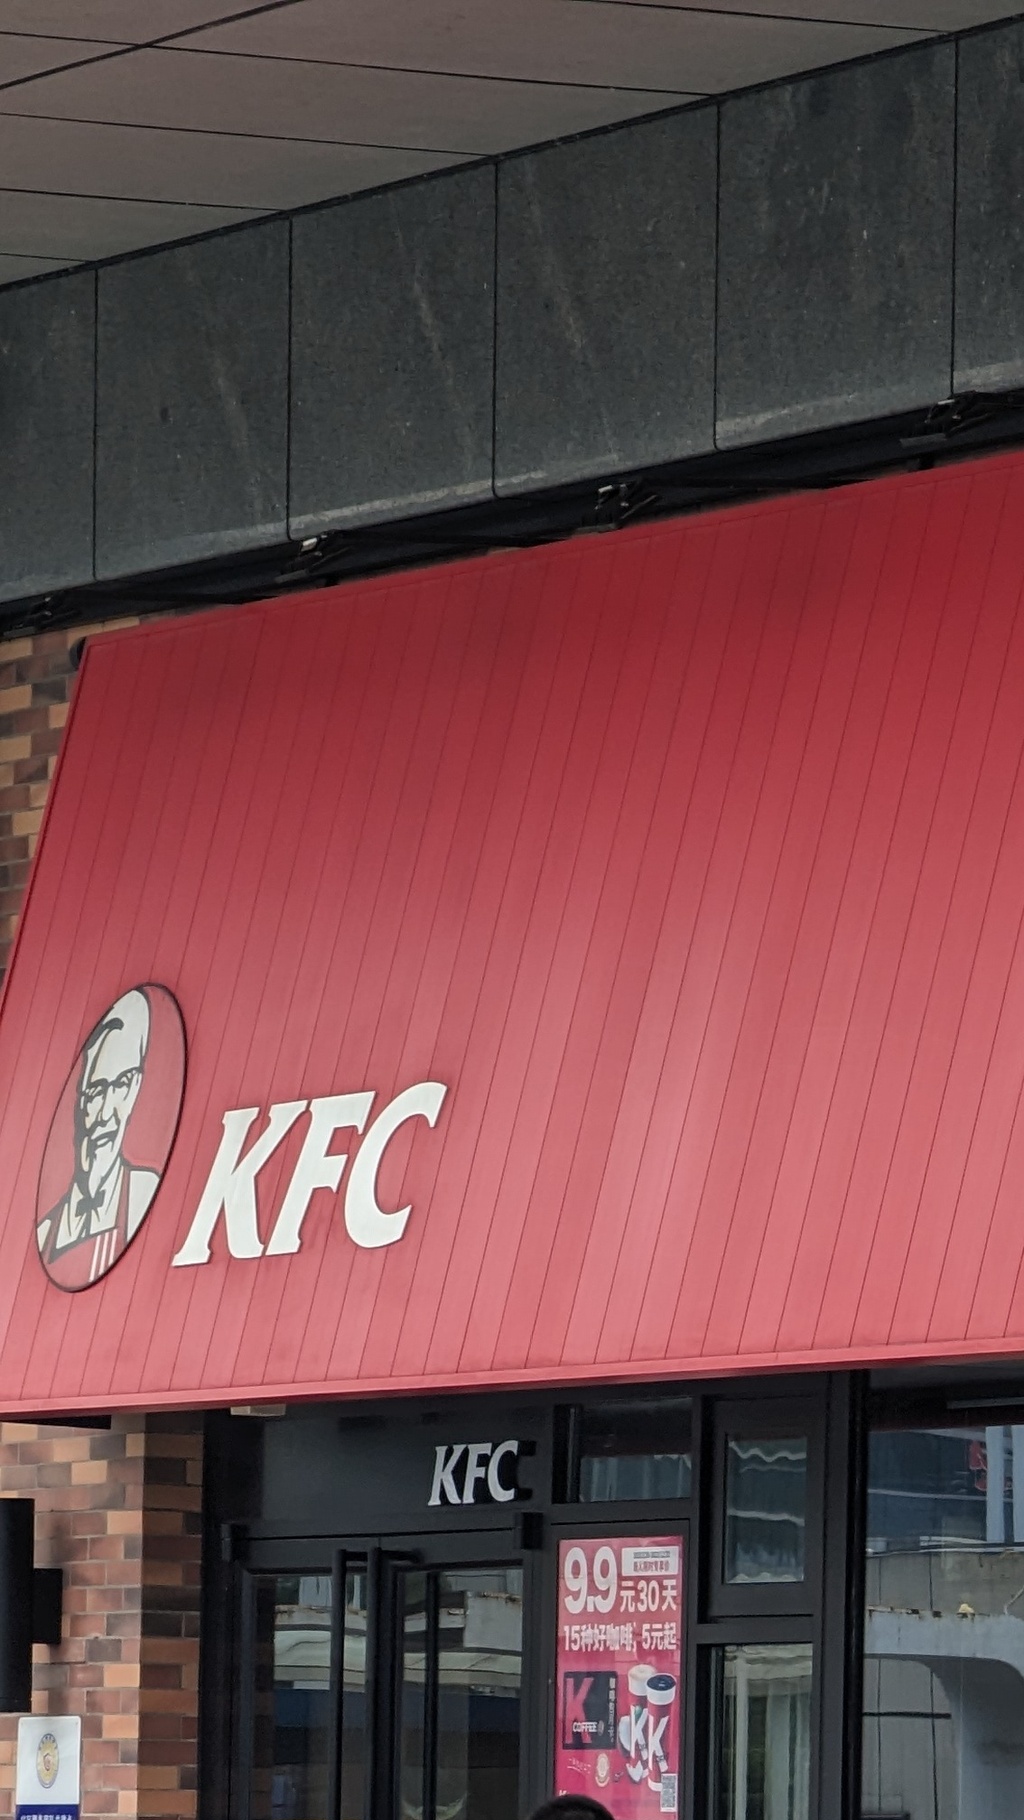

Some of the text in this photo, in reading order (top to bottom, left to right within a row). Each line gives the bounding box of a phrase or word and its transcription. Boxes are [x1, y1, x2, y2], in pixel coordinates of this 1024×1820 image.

[171, 1080, 449, 1268] KFC
[427, 1439, 519, 1507] KFC
[564, 1546, 677, 1614] 9.9 元30天
[572, 1721, 598, 1733] COFFEE
